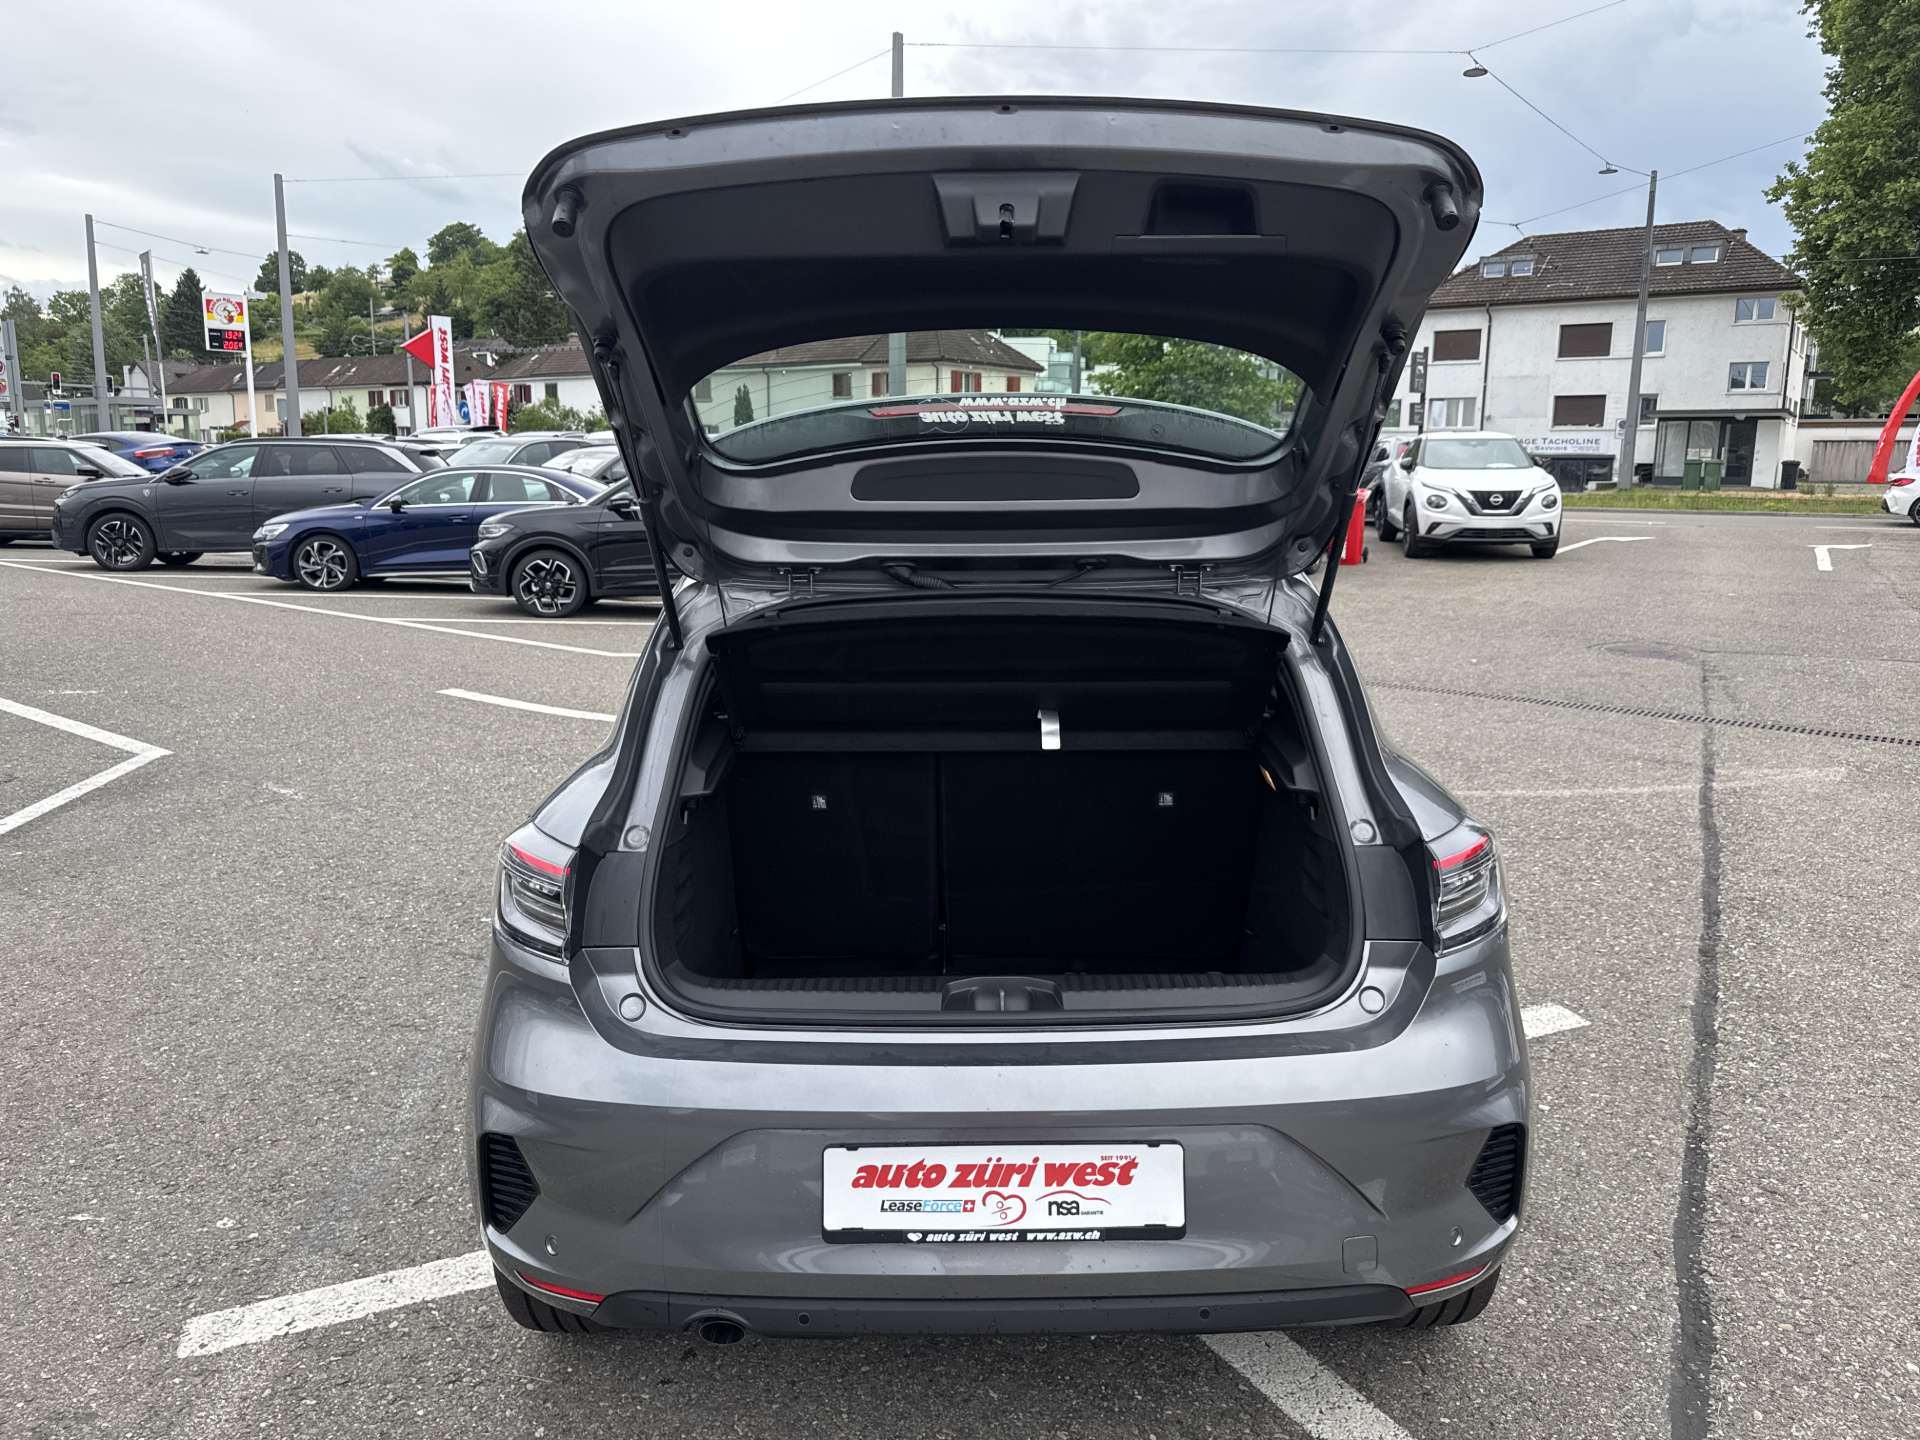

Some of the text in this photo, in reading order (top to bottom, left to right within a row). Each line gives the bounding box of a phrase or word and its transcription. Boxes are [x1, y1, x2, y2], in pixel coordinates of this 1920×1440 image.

[439, 328, 449, 364] west
[851, 1156, 1139, 1189] auto züri west
[880, 1199, 963, 1212] LeaseForce
[1048, 1200, 1080, 1216] nsa
[926, 1230, 1100, 1242] auto züri west www.azw.ch
